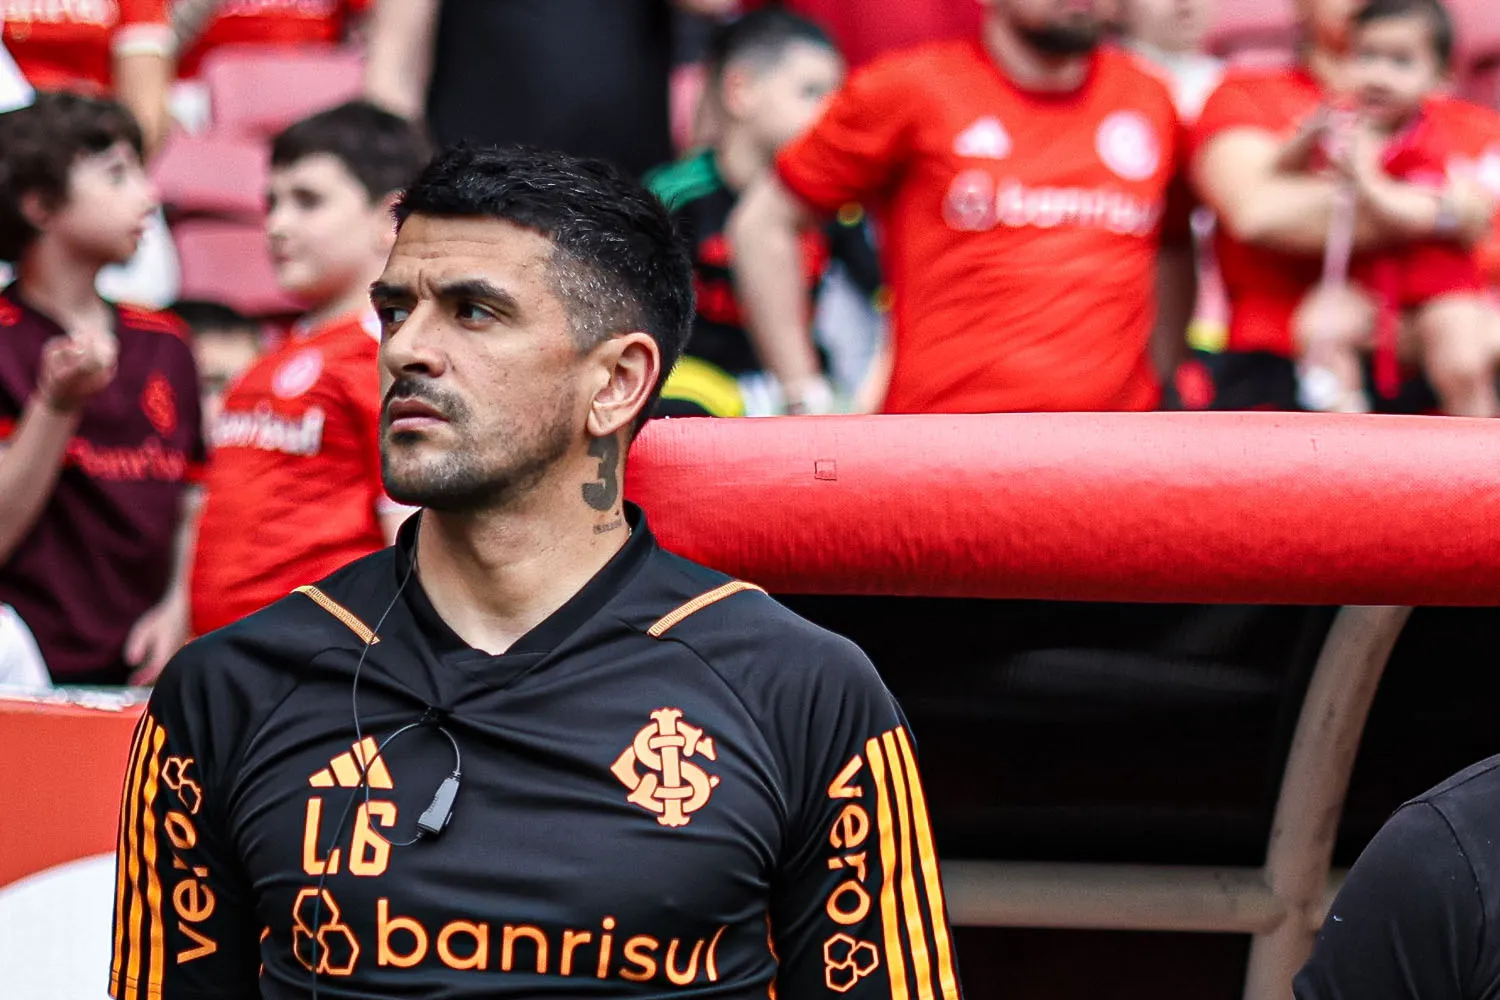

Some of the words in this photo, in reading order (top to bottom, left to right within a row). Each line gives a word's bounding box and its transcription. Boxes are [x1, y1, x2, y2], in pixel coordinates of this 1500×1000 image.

[582, 433, 619, 511] 3
[303, 796, 397, 877] L6
[826, 754, 871, 925] vero
[164, 811, 218, 964] vero
[377, 897, 729, 986] banrisul
